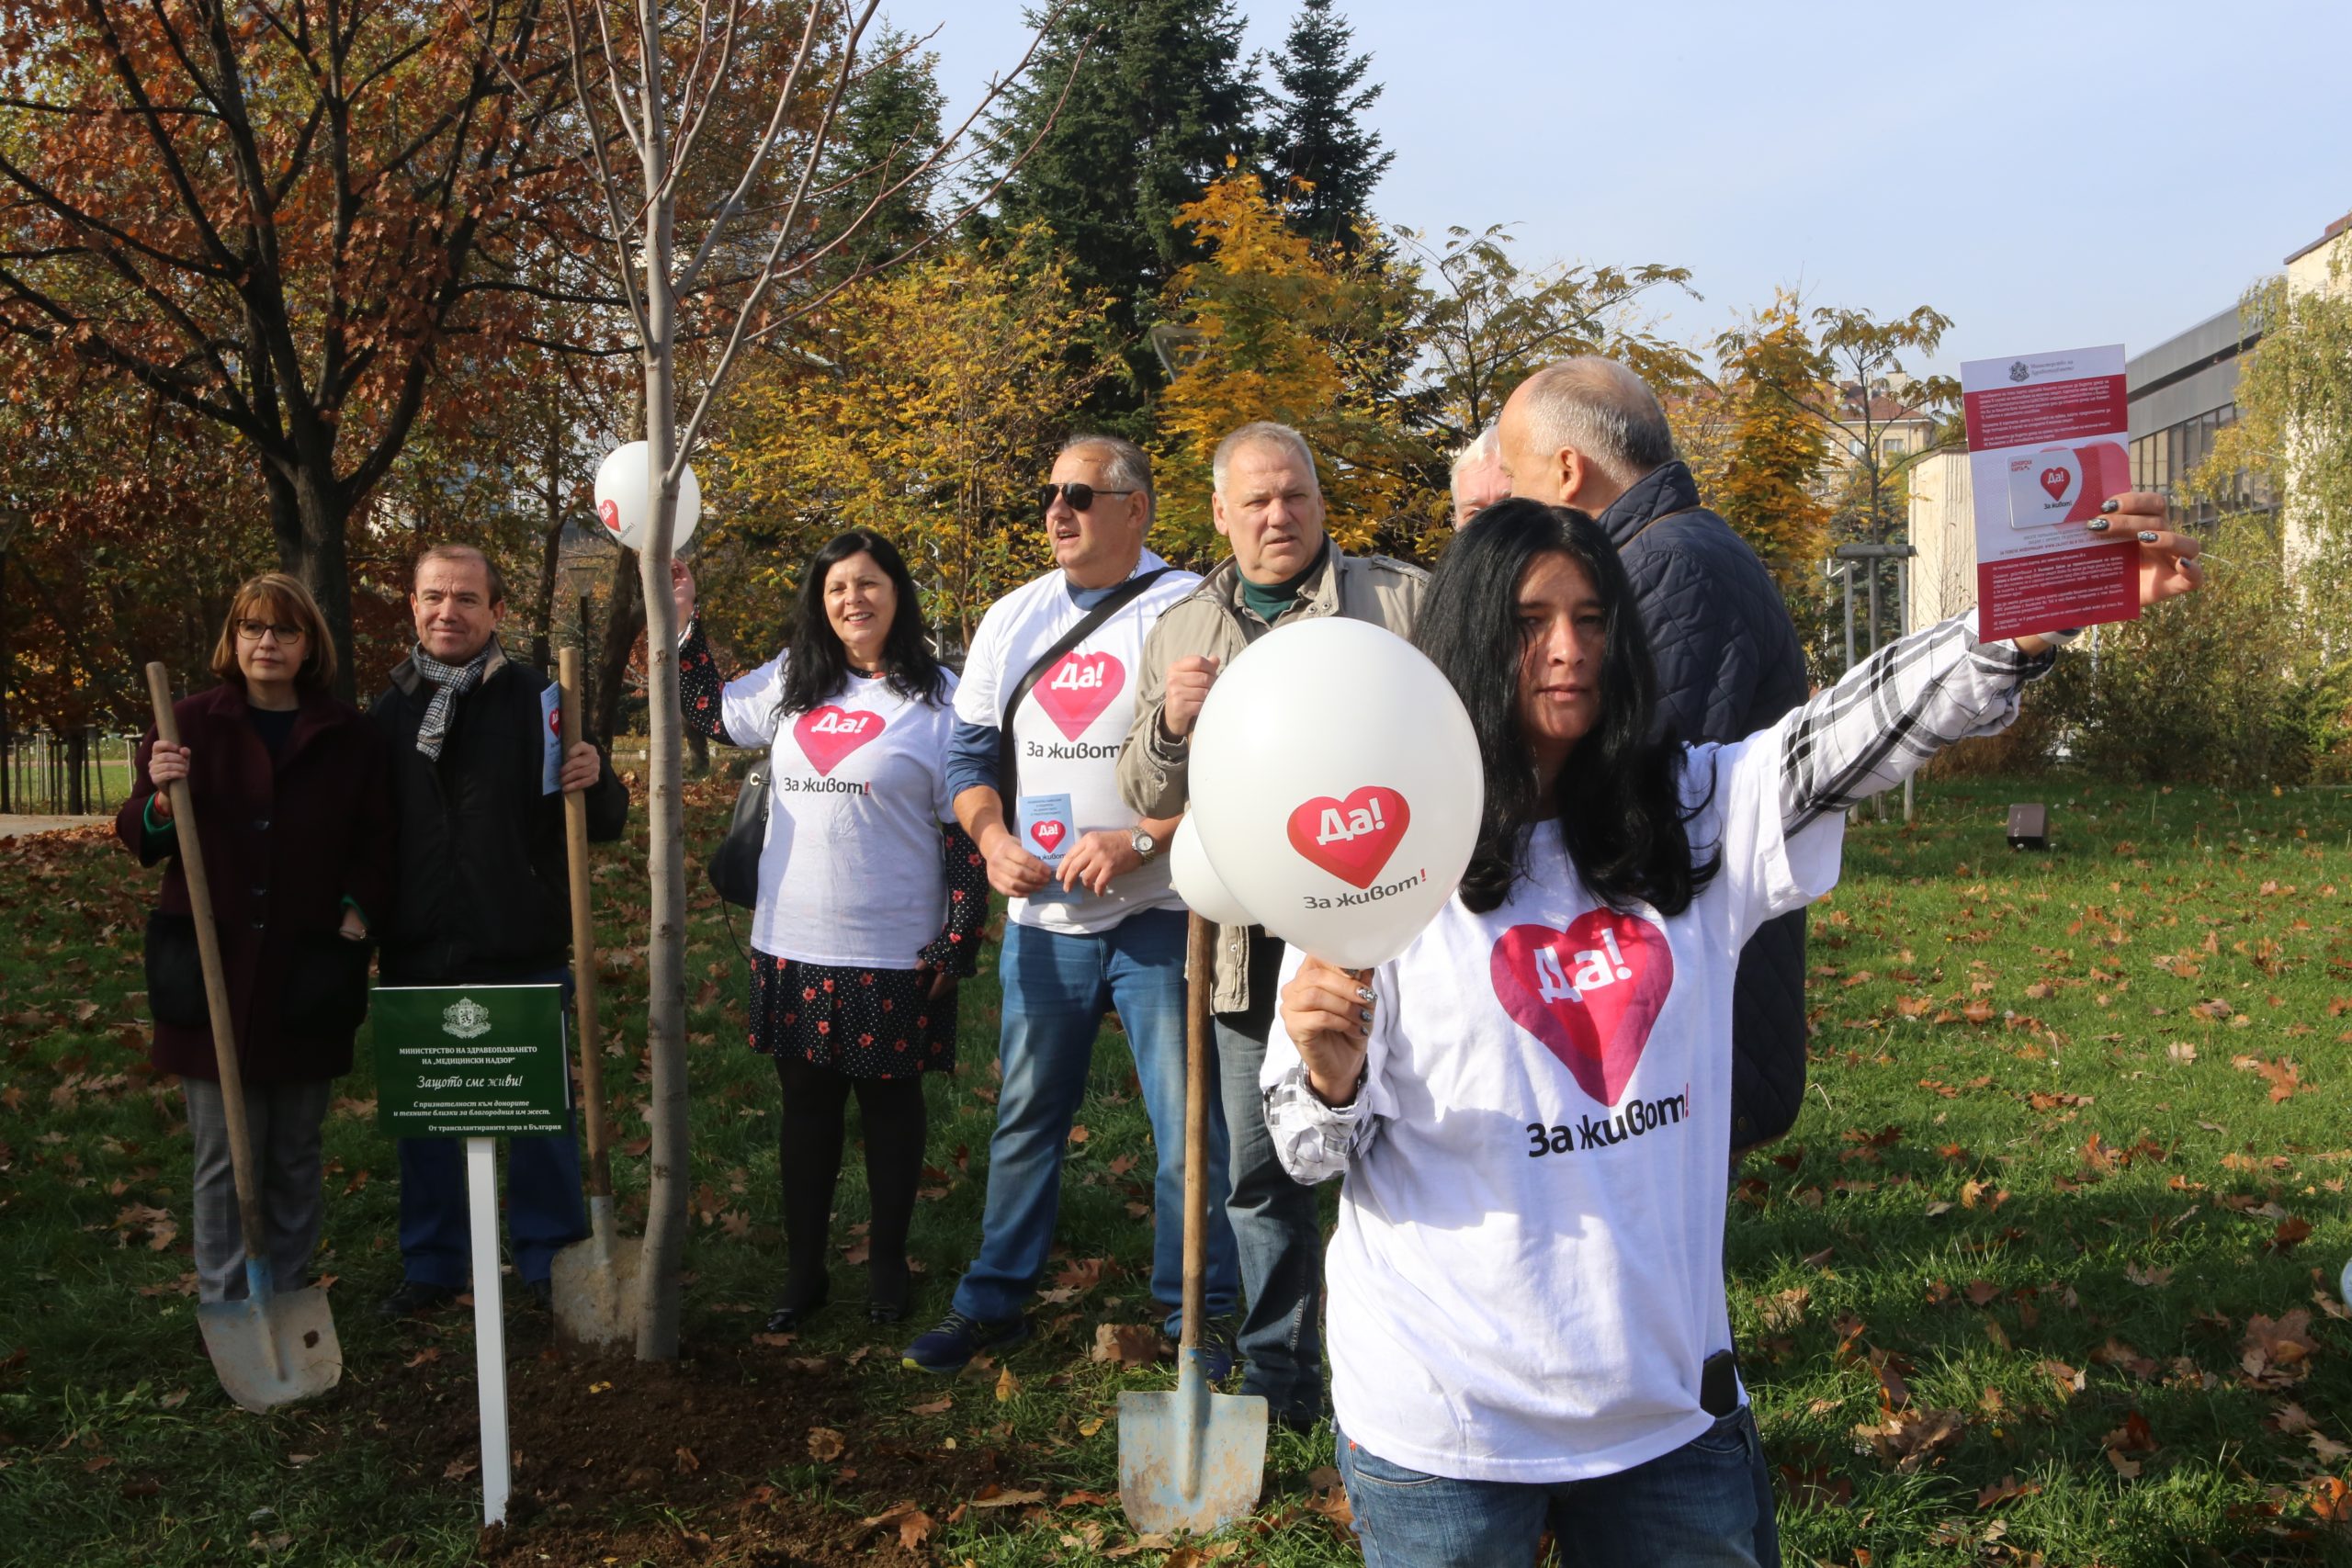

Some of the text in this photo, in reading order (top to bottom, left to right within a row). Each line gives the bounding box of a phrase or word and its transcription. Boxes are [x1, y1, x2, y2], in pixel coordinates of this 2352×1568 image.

[2047, 470, 2064, 485] Да!
[1050, 661, 1105, 691] Да!
[810, 712, 869, 734] Да!
[1026, 740, 1044, 757] За
[784, 777, 870, 795] За живот!
[1316, 797, 1385, 846] Да!
[1038, 823, 1058, 838] Да!
[1303, 868, 1427, 909] За живот!
[1532, 927, 1633, 1004] Да!
[466, 1045, 537, 1055] ЗДРАВЕОПАЗВАНЕТО
[417, 1075, 523, 1090] Защото сме живи!
[493, 1100, 529, 1108] донорите
[433, 1109, 458, 1117] близки
[469, 1109, 514, 1118] благородния
[1526, 1082, 1690, 1158] За живот!
[438, 1124, 505, 1133] трансплантираните
[528, 1123, 561, 1133] България
